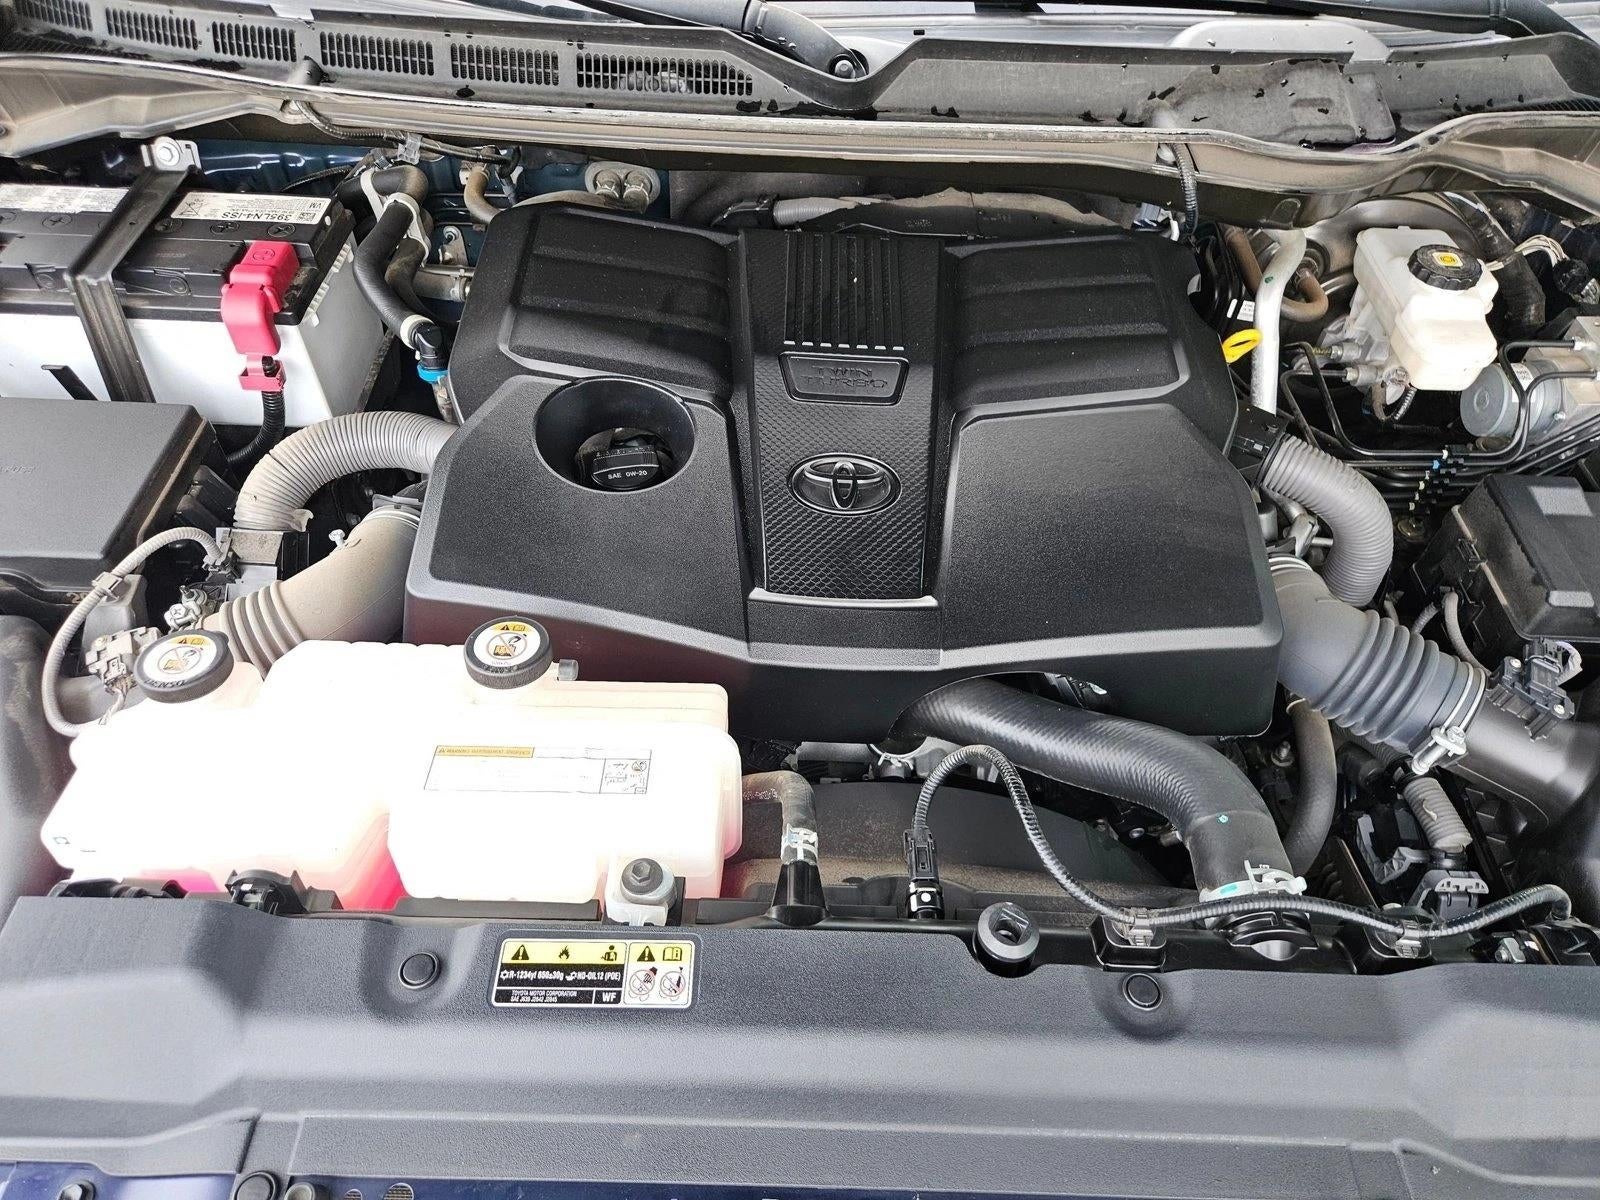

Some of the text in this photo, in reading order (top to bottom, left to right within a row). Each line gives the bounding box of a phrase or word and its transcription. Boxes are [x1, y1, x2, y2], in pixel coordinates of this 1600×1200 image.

[221, 212, 292, 222] 395LN4-ISS
[812, 365, 873, 378] TWIN
[800, 374, 888, 389] TURBO
[604, 972, 621, 981] (POE)
[602, 992, 617, 1002] WF
